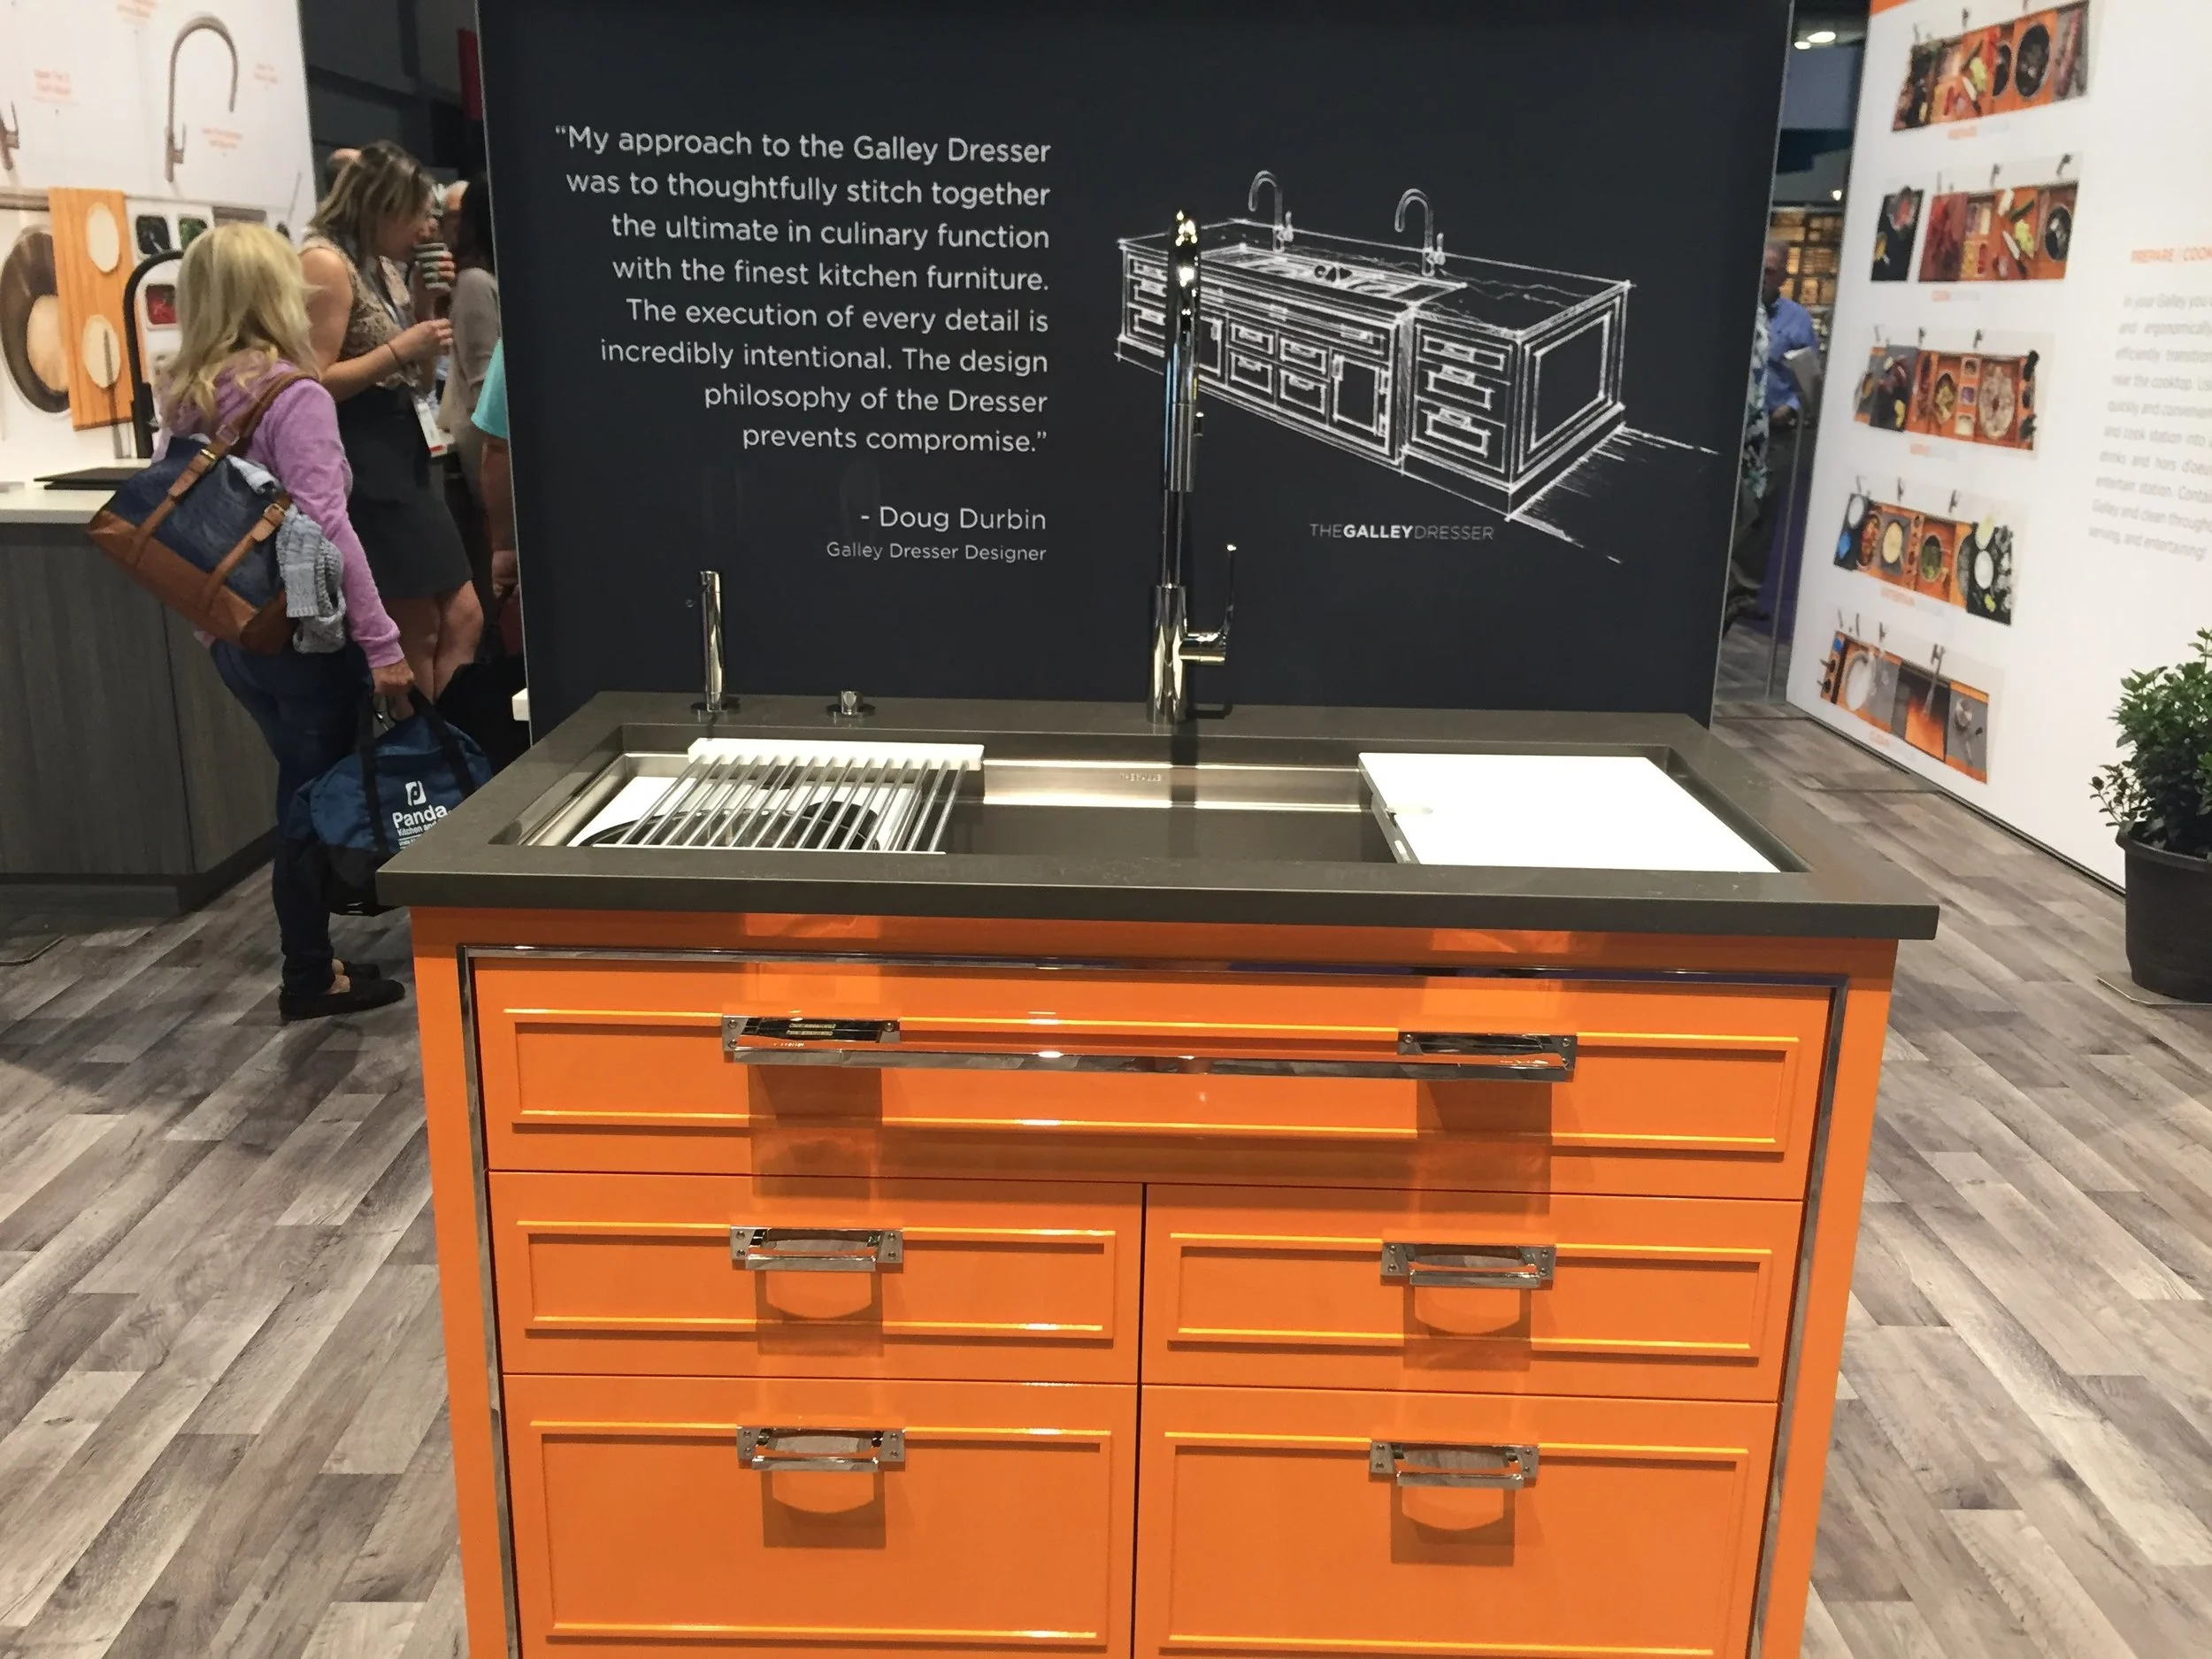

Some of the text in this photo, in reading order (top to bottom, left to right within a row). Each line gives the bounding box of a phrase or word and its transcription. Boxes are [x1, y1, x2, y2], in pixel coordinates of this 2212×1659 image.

[618, 130, 752, 157] approach
[761, 134, 791, 157] to
[799, 133, 845, 159] the
[853, 134, 939, 166] Galley
[948, 136, 1052, 164] Dresser
[565, 172, 1051, 210] was to thoughtfully stitch together
[611, 212, 1049, 251] the ultimate in culinary function
[611, 256, 1049, 291] with the finest kitchen furniture.
[626, 297, 1048, 334] The execution of every detail is
[601, 340, 1048, 377] incredibly intentional. The design
[704, 382, 1048, 413] philosophy of the Dresser
[742, 426, 857, 450] prevents
[879, 505, 949, 533] Doug
[959, 507, 1046, 530] Durbin
[826, 541, 1048, 564] Galley Dresser Designer
[392, 804, 449, 829] Panda
[397, 826, 423, 837] Kitchen
